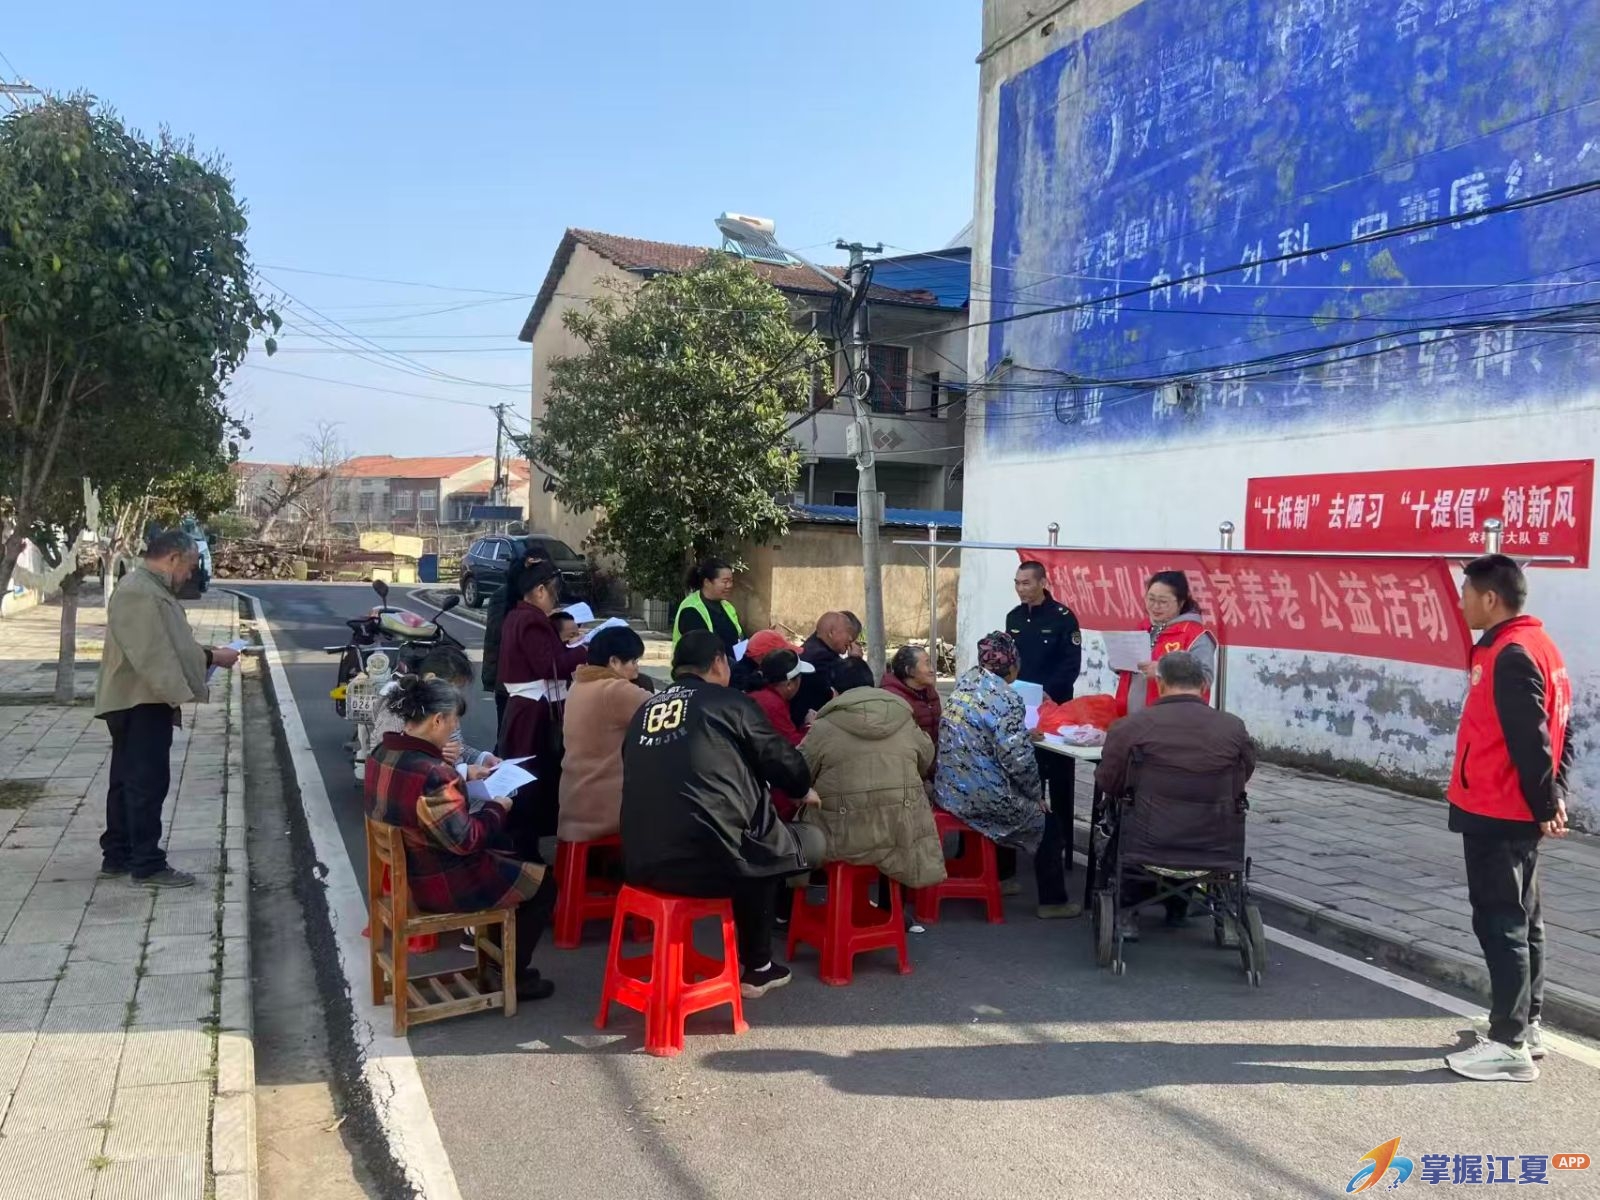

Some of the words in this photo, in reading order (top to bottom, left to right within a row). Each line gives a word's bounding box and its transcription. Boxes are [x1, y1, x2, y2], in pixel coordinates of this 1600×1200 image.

[1328, 492, 1385, 529] 去陋习
[1502, 484, 1576, 529] 树新风
[1309, 570, 1449, 643] 公益活动
[647, 698, 684, 734] 83
